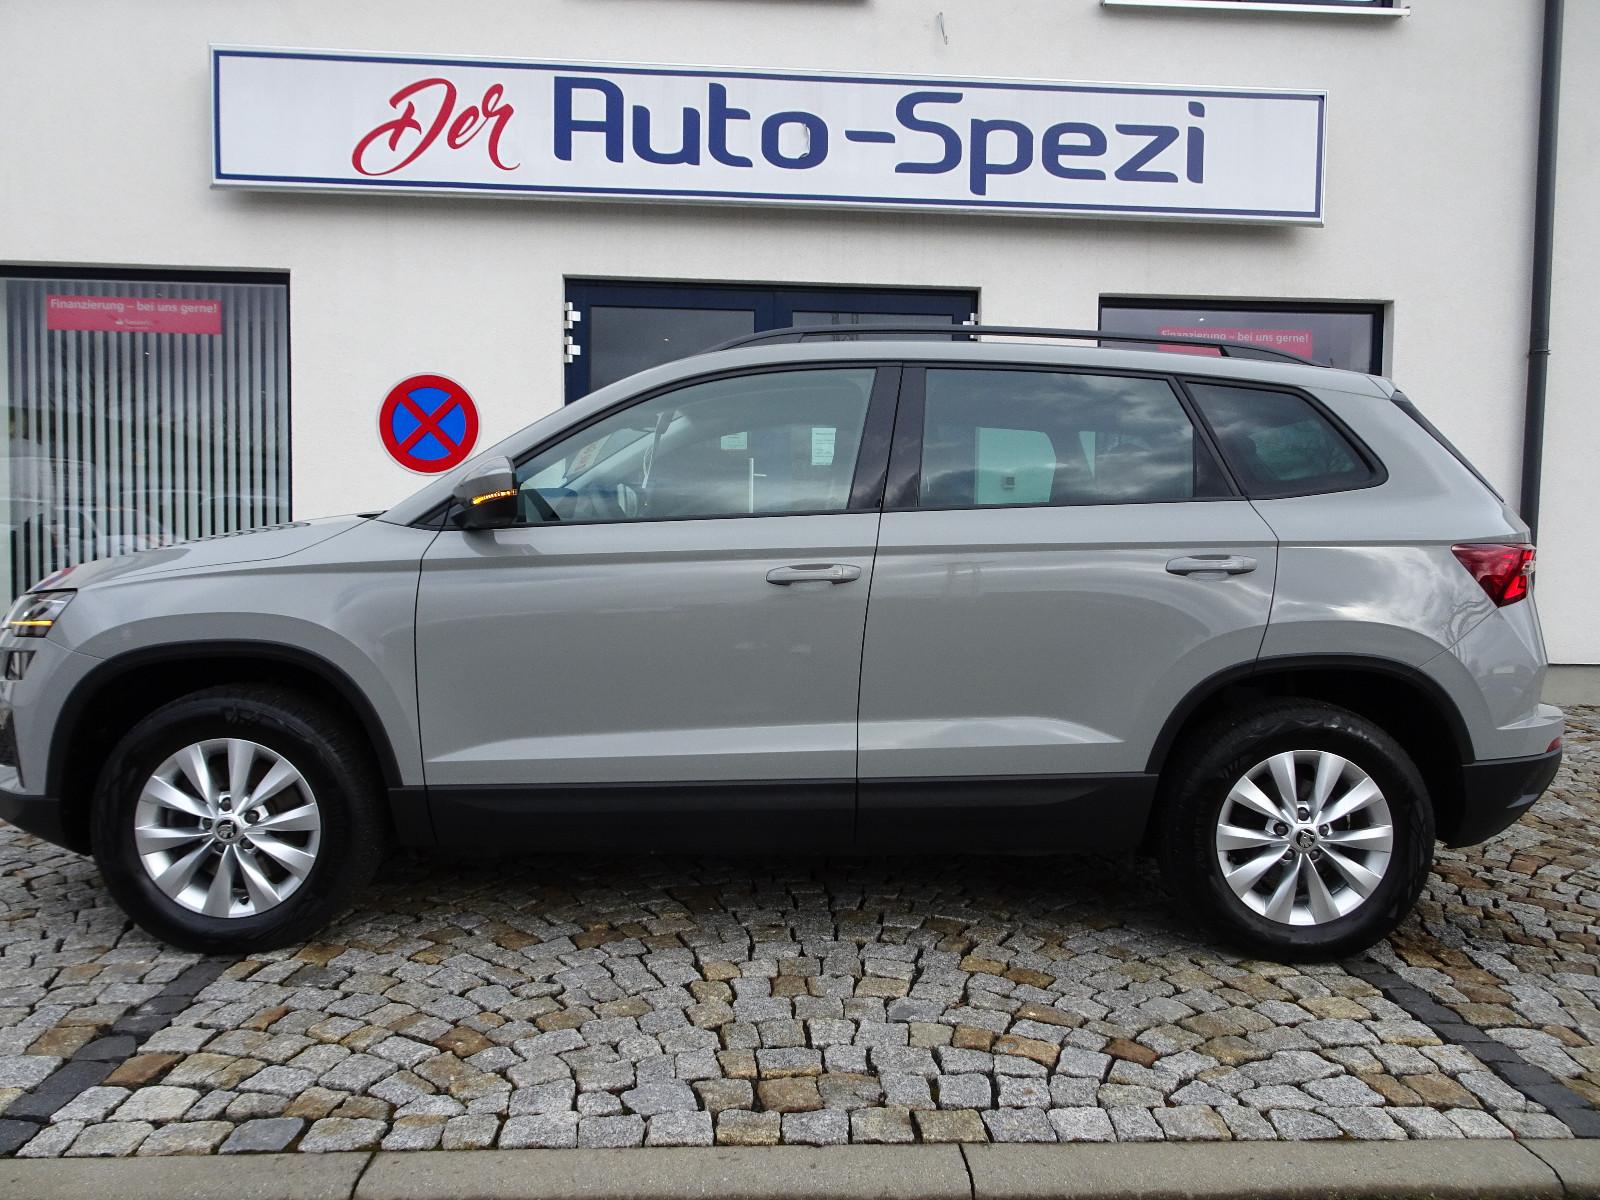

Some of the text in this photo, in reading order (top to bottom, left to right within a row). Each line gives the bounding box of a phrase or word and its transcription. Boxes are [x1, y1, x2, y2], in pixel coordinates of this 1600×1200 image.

[353, 76, 1206, 196] Der Auto-Spezi
[50, 299, 125, 312] Finanzierung
[137, 301, 154, 311] bei
[157, 303, 177, 312] uns
[181, 304, 217, 315] gerne!
[1237, 331, 1252, 341] bei
[1276, 334, 1308, 344] gerne!
